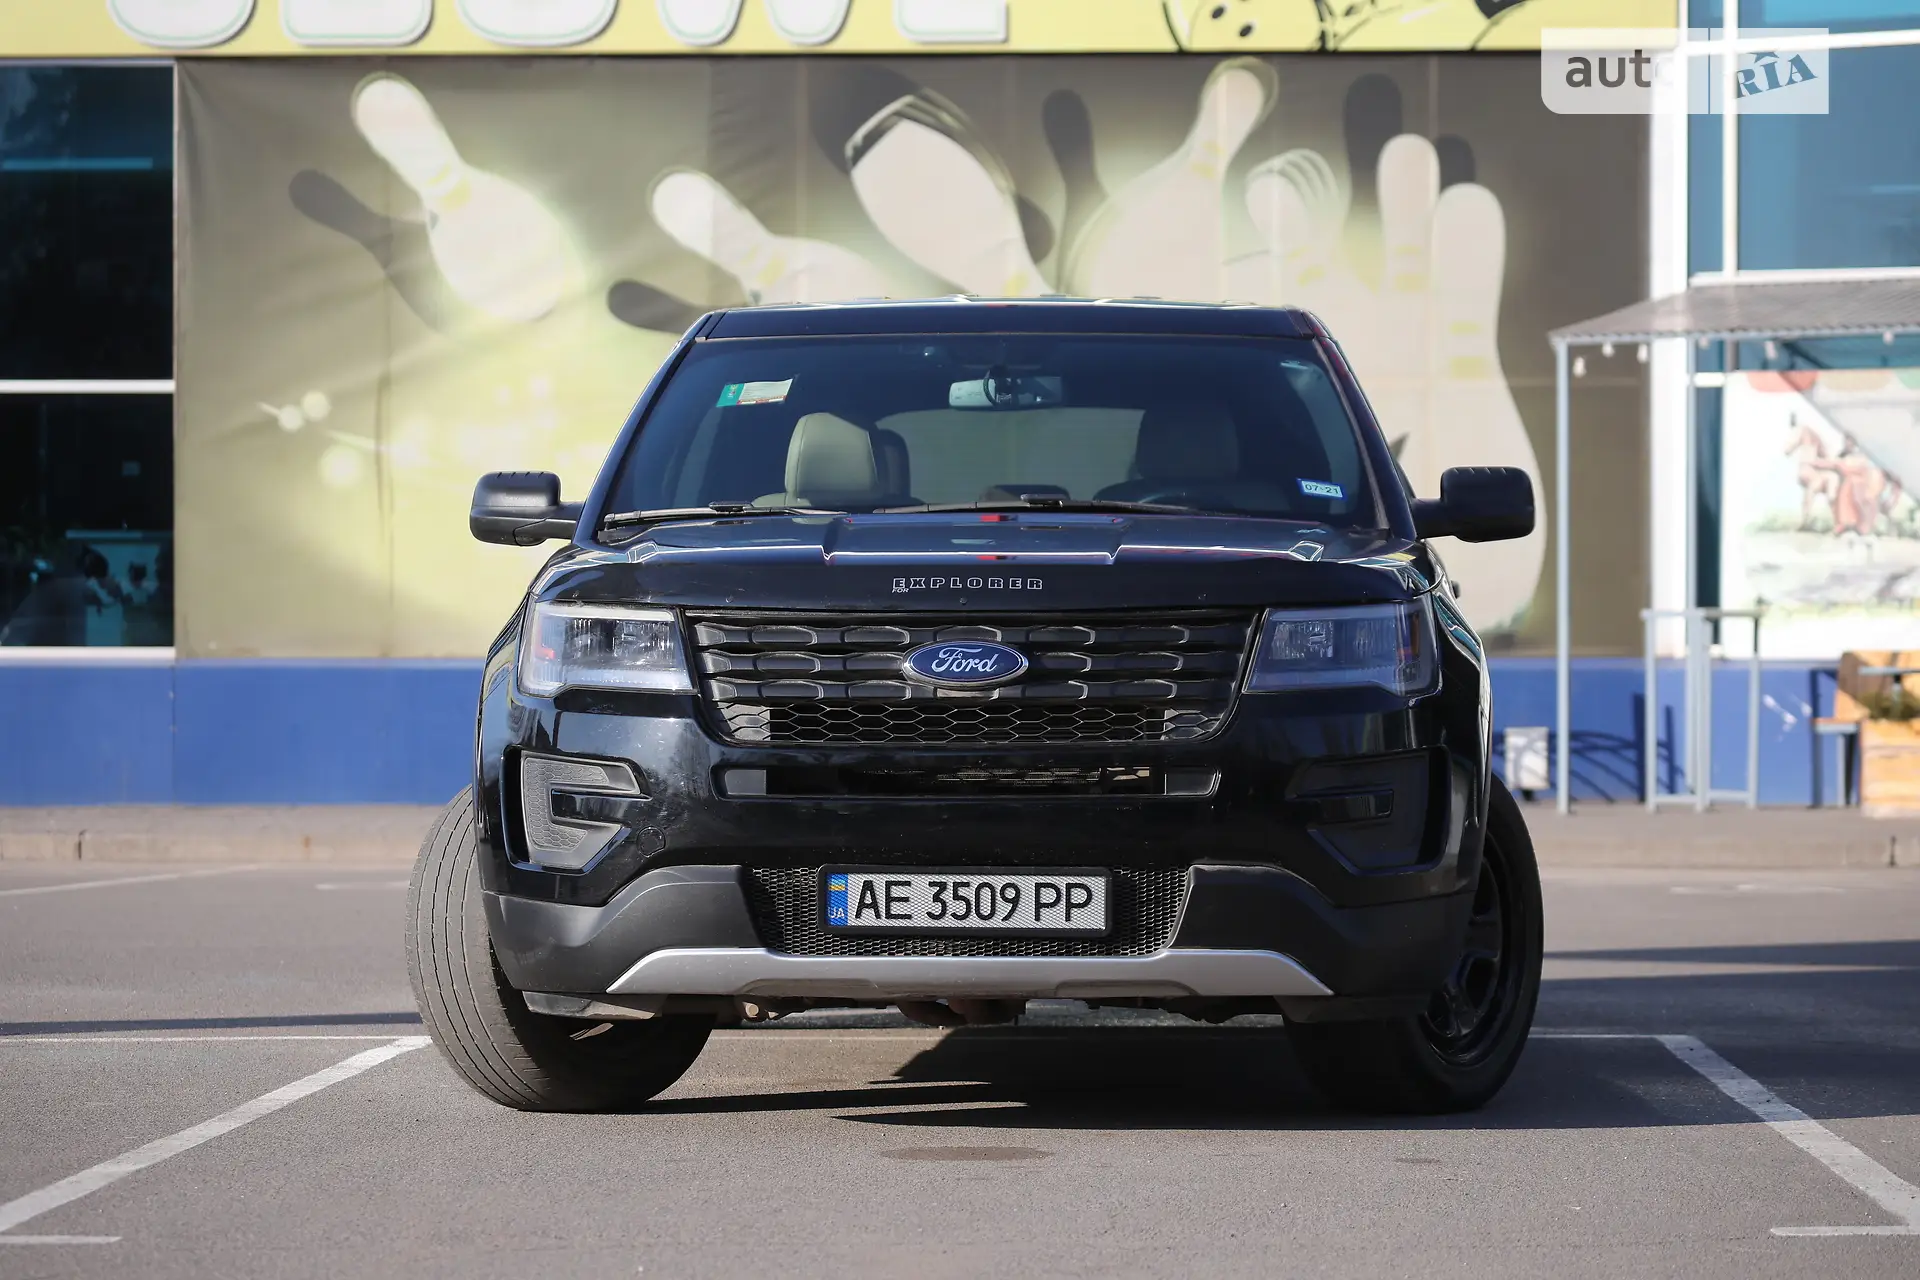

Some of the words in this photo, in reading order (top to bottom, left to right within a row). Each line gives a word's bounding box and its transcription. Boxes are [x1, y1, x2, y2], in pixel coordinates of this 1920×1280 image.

[892, 577, 1043, 590] EXPLORER
[931, 647, 999, 673] Ford
[854, 880, 912, 920] AE
[926, 881, 1021, 922] 3509
[1034, 882, 1093, 922] PP
[827, 906, 845, 919] UA
